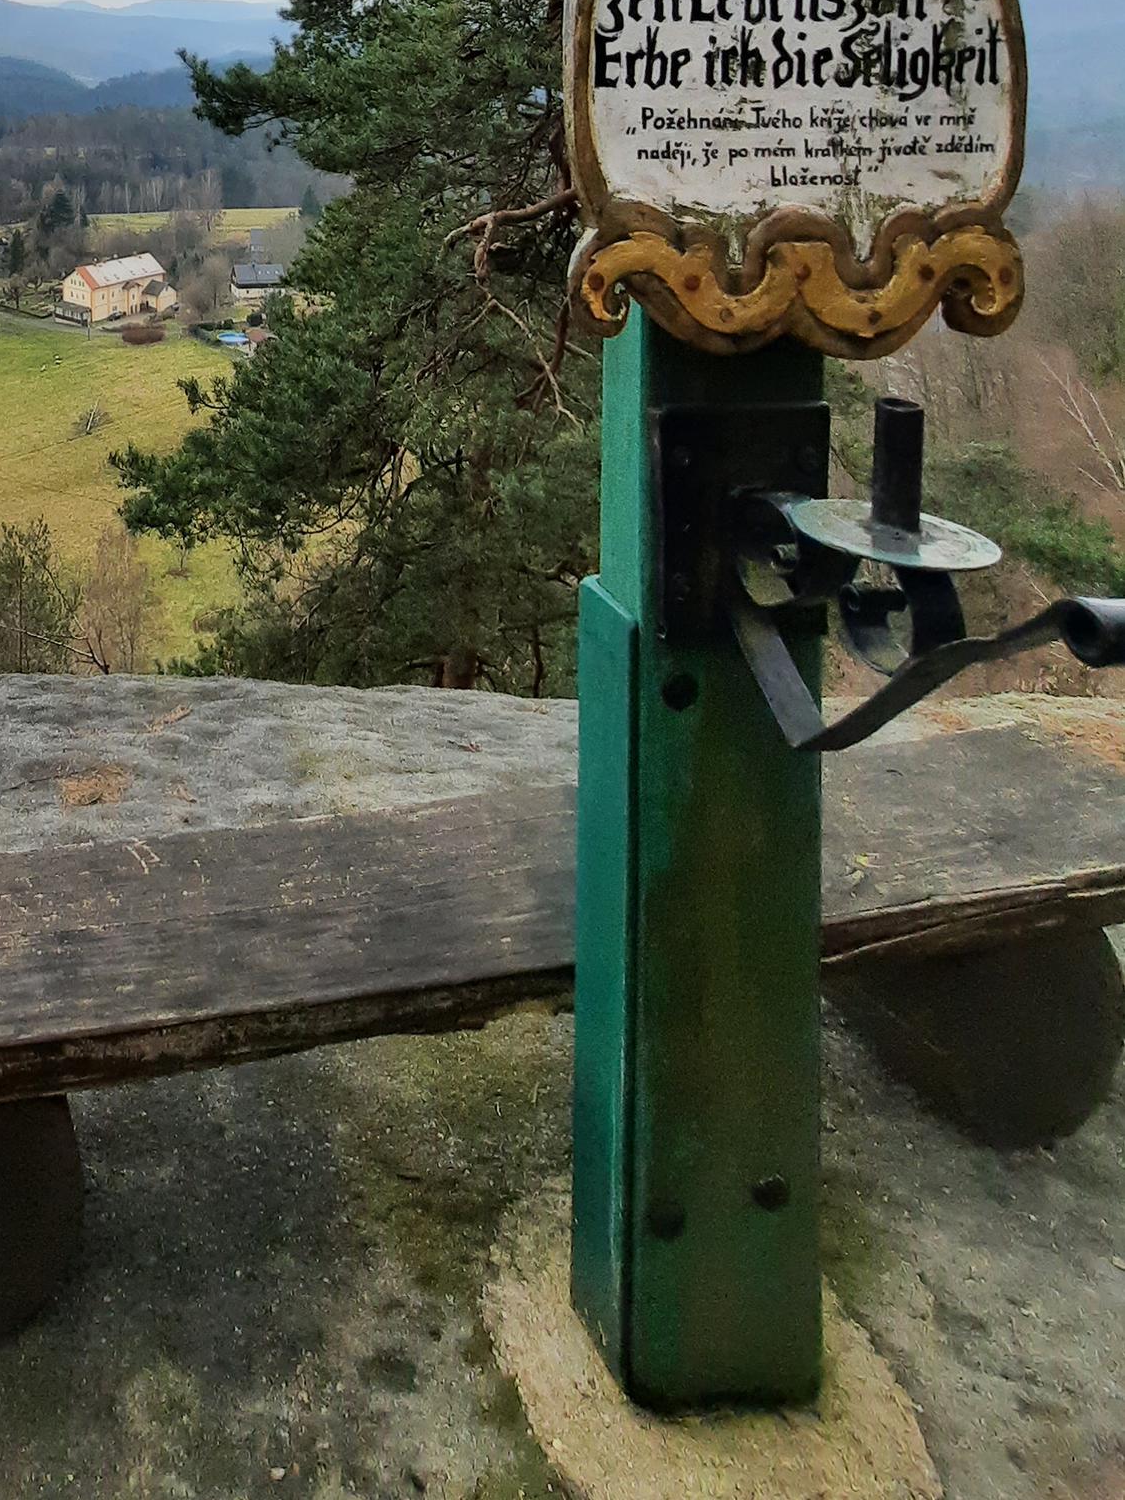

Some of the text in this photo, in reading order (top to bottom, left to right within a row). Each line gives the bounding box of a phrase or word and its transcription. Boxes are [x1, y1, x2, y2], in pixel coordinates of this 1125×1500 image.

[594, 19, 1005, 100] Erbe ich die Seligkeit
[750, 106, 803, 130] Tvého
[809, 106, 851, 134] kříže
[859, 106, 908, 132] chová
[915, 112, 932, 127] ve
[939, 107, 977, 127] mně
[701, 141, 719, 167] že
[728, 147, 749, 166] po
[754, 138, 796, 159] mém
[935, 134, 995, 154] zdědím
